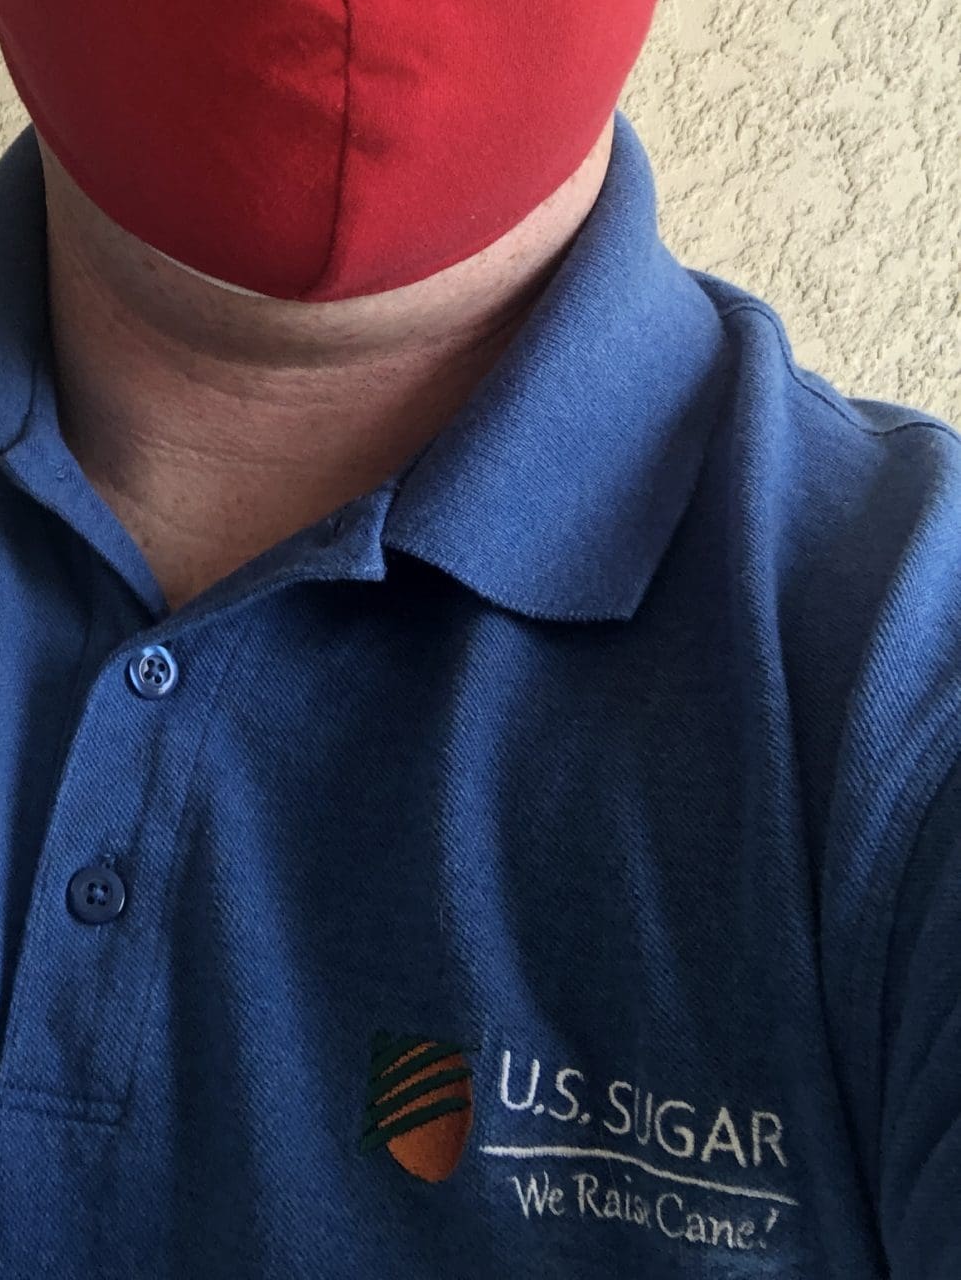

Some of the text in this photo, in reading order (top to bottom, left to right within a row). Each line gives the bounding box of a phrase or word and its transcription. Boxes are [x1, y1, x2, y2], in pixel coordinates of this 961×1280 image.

[500, 1050, 790, 1169] U.S. SUGAR
[512, 1170, 780, 1250] We Rais Cane!
